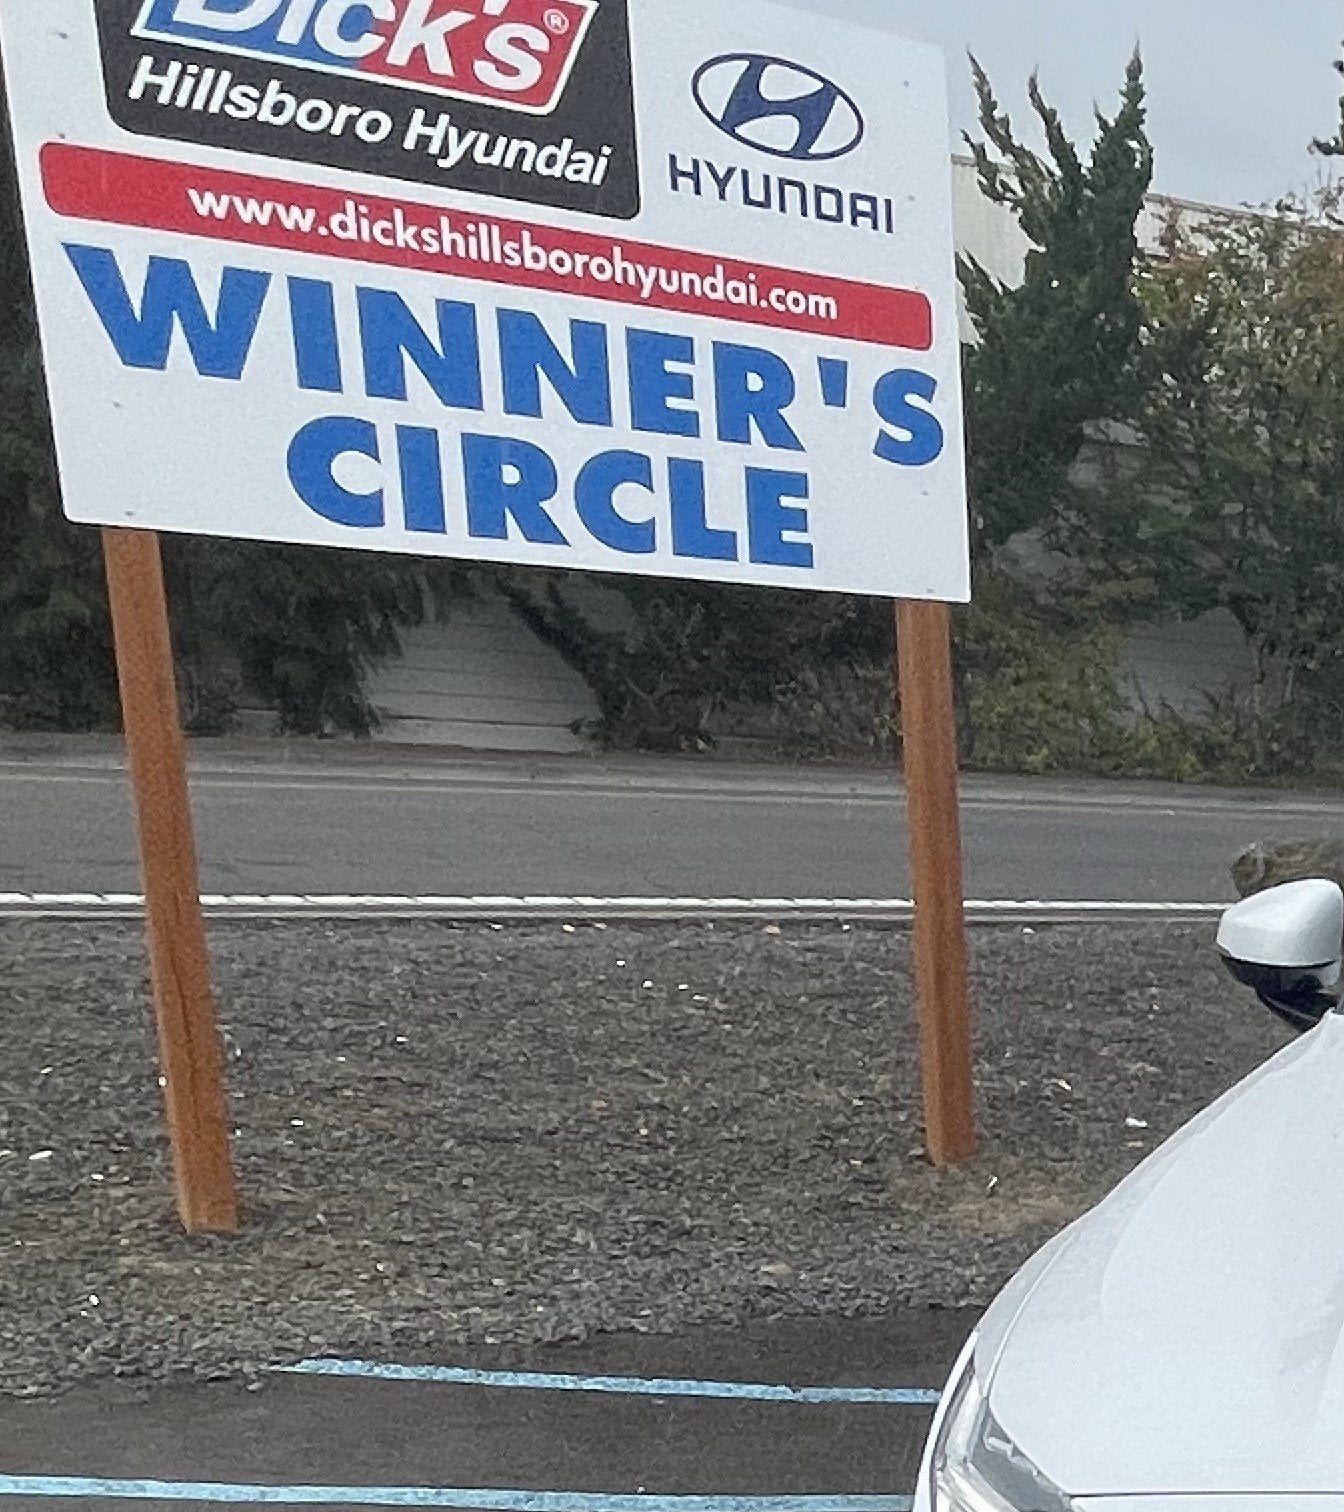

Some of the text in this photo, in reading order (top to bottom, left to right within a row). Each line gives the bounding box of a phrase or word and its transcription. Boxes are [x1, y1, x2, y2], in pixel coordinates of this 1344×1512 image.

[172, 0, 551, 92] ck's
[128, 55, 613, 187] Hillsboro Hyundai
[186, 187, 839, 321] www.dickshillsborohyundai.com
[668, 152, 895, 235] HYUNDAI
[60, 241, 945, 466] WINNER'S
[286, 414, 815, 570] CIRCLE
